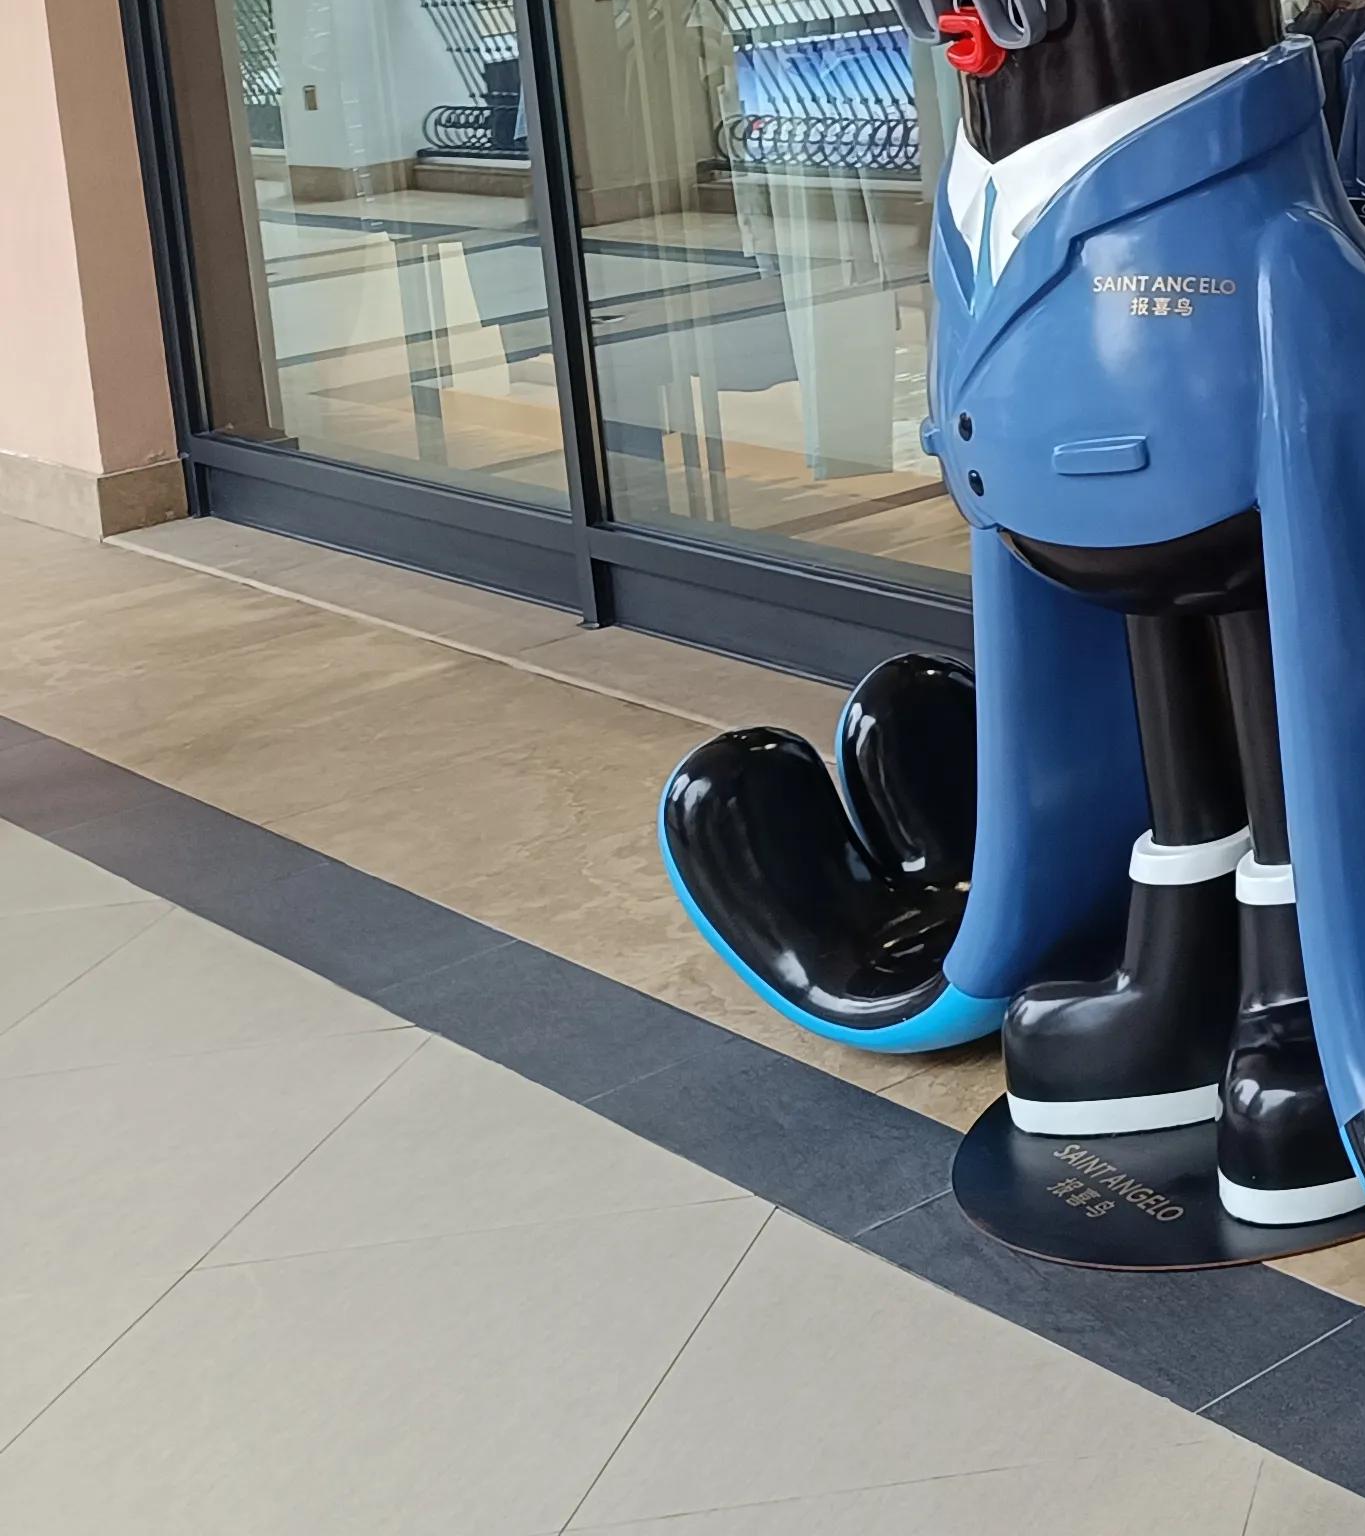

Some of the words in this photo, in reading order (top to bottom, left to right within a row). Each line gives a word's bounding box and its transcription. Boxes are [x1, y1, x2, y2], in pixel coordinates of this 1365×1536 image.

[1093, 275, 1149, 292] SAINT
[1131, 297, 1193, 317] 报喜鸟
[1046, 1177, 1115, 1218] 报喜鸟
[1053, 1144, 1117, 1178] SAINT
[1099, 1173, 1184, 1221] ANGELO
